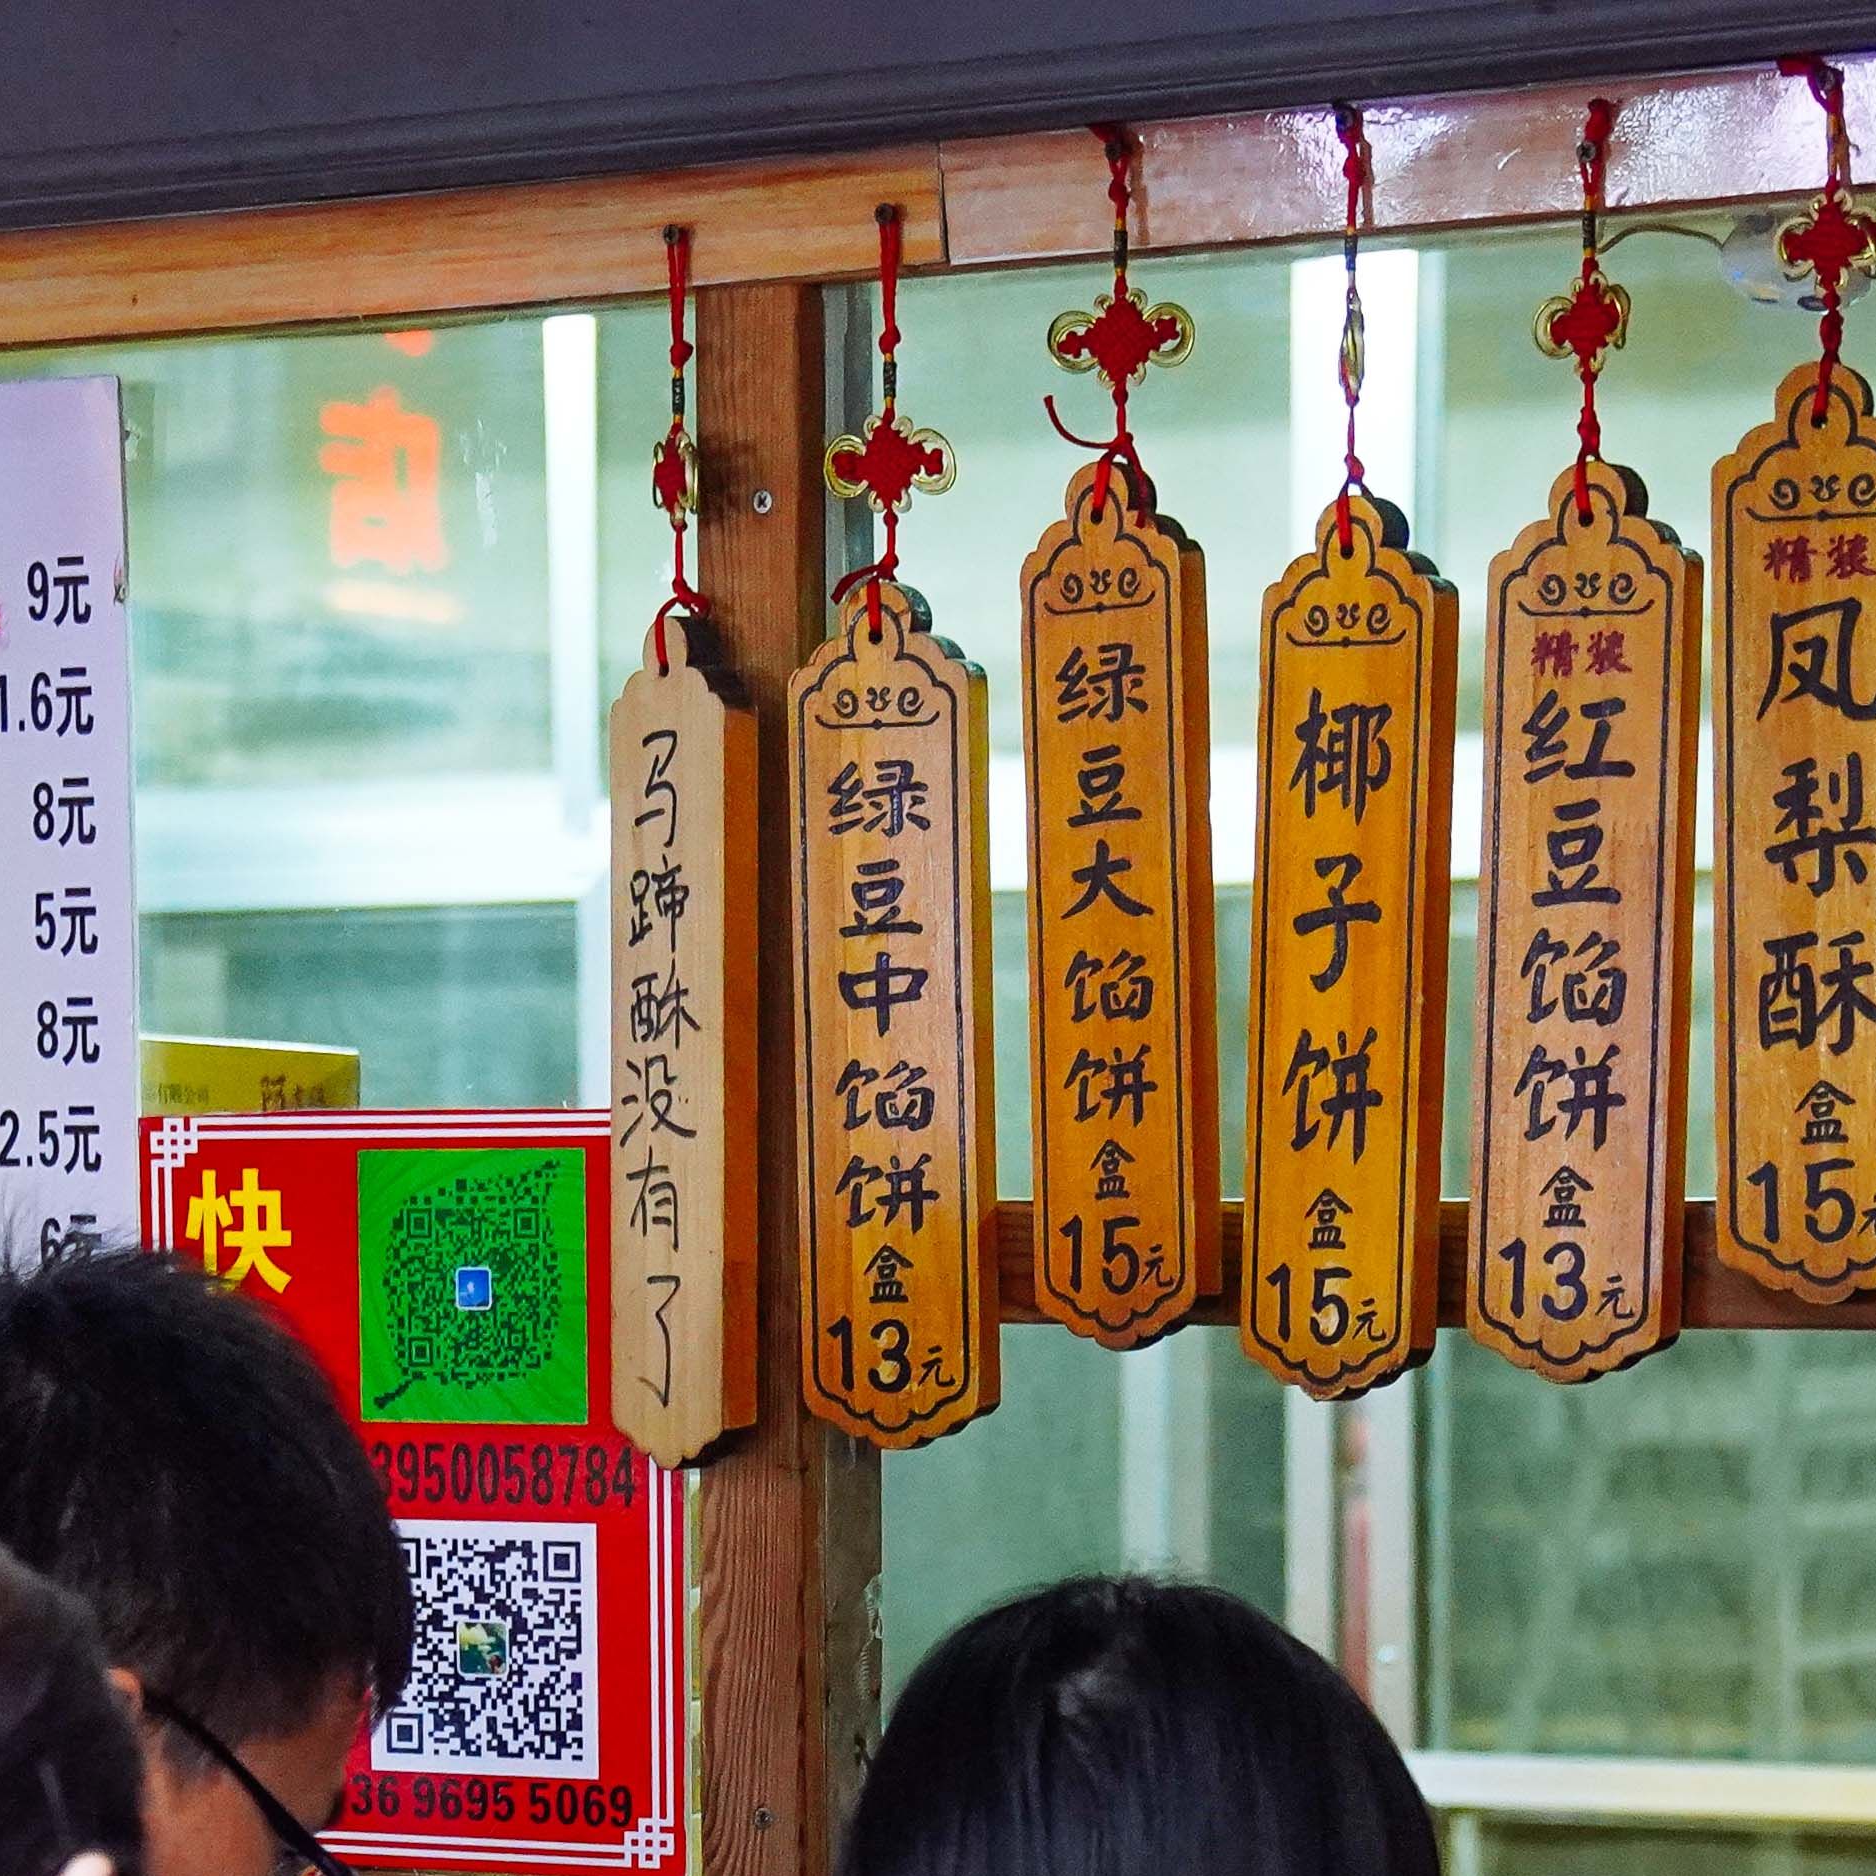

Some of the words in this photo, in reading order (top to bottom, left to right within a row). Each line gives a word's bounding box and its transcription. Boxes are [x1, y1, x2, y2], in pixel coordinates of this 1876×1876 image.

[27, 556, 92, 625] 9元
[1532, 629, 1634, 680] 精装
[32, 777, 97, 846] 8元
[1053, 643, 1157, 1129] 绿豆大馅饼
[1513, 688, 1638, 1150] 红豆馅饼
[34, 888, 99, 957] 5元
[1282, 688, 1391, 1165] 椰子饼
[827, 760, 938, 1233] 绿豆中馅饼
[36, 998, 102, 1066] 8元
[0, 1106, 103, 1174] 2.5元
[1795, 1079, 1851, 1146] 盒
[1089, 1141, 1134, 1200] 盒
[1539, 1166, 1594, 1228] 盒
[185, 1168, 292, 1294] 快
[1304, 1188, 1349, 1252] 盒
[862, 1244, 913, 1305] 盒
[1059, 1216, 1174, 1297] 15元
[1497, 1238, 1636, 1321] 13元
[1265, 1264, 1388, 1346] 15元
[827, 1316, 956, 1395] 13元
[413, 1777, 515, 1821] 9695
[529, 1783, 633, 1827] 5069
